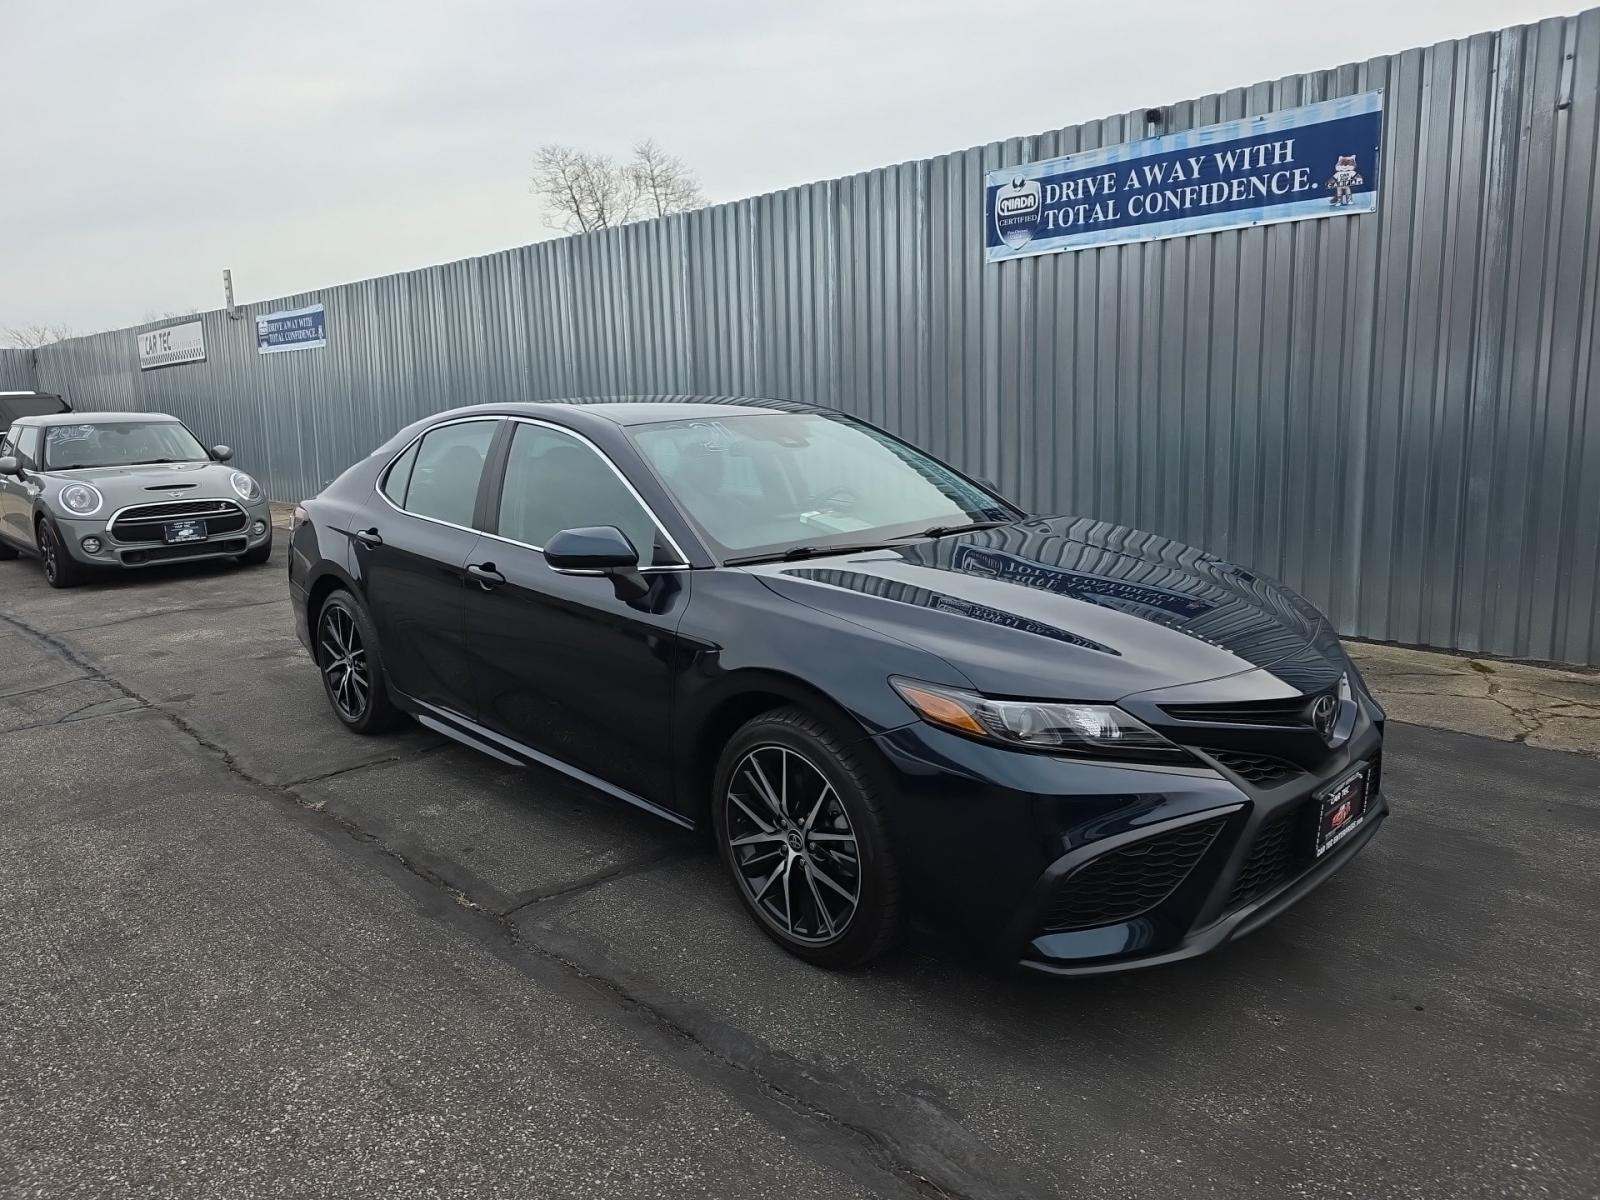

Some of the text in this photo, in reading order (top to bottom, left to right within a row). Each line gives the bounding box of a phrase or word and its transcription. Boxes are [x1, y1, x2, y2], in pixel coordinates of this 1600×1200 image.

[1044, 138, 1296, 205] DRIVE AWAY WITH
[1044, 167, 1319, 230] TOTAL CONFIDENCE.
[999, 214, 1038, 227] CERTIFIED
[145, 334, 158, 355] CAR
[159, 331, 172, 352] TEC
